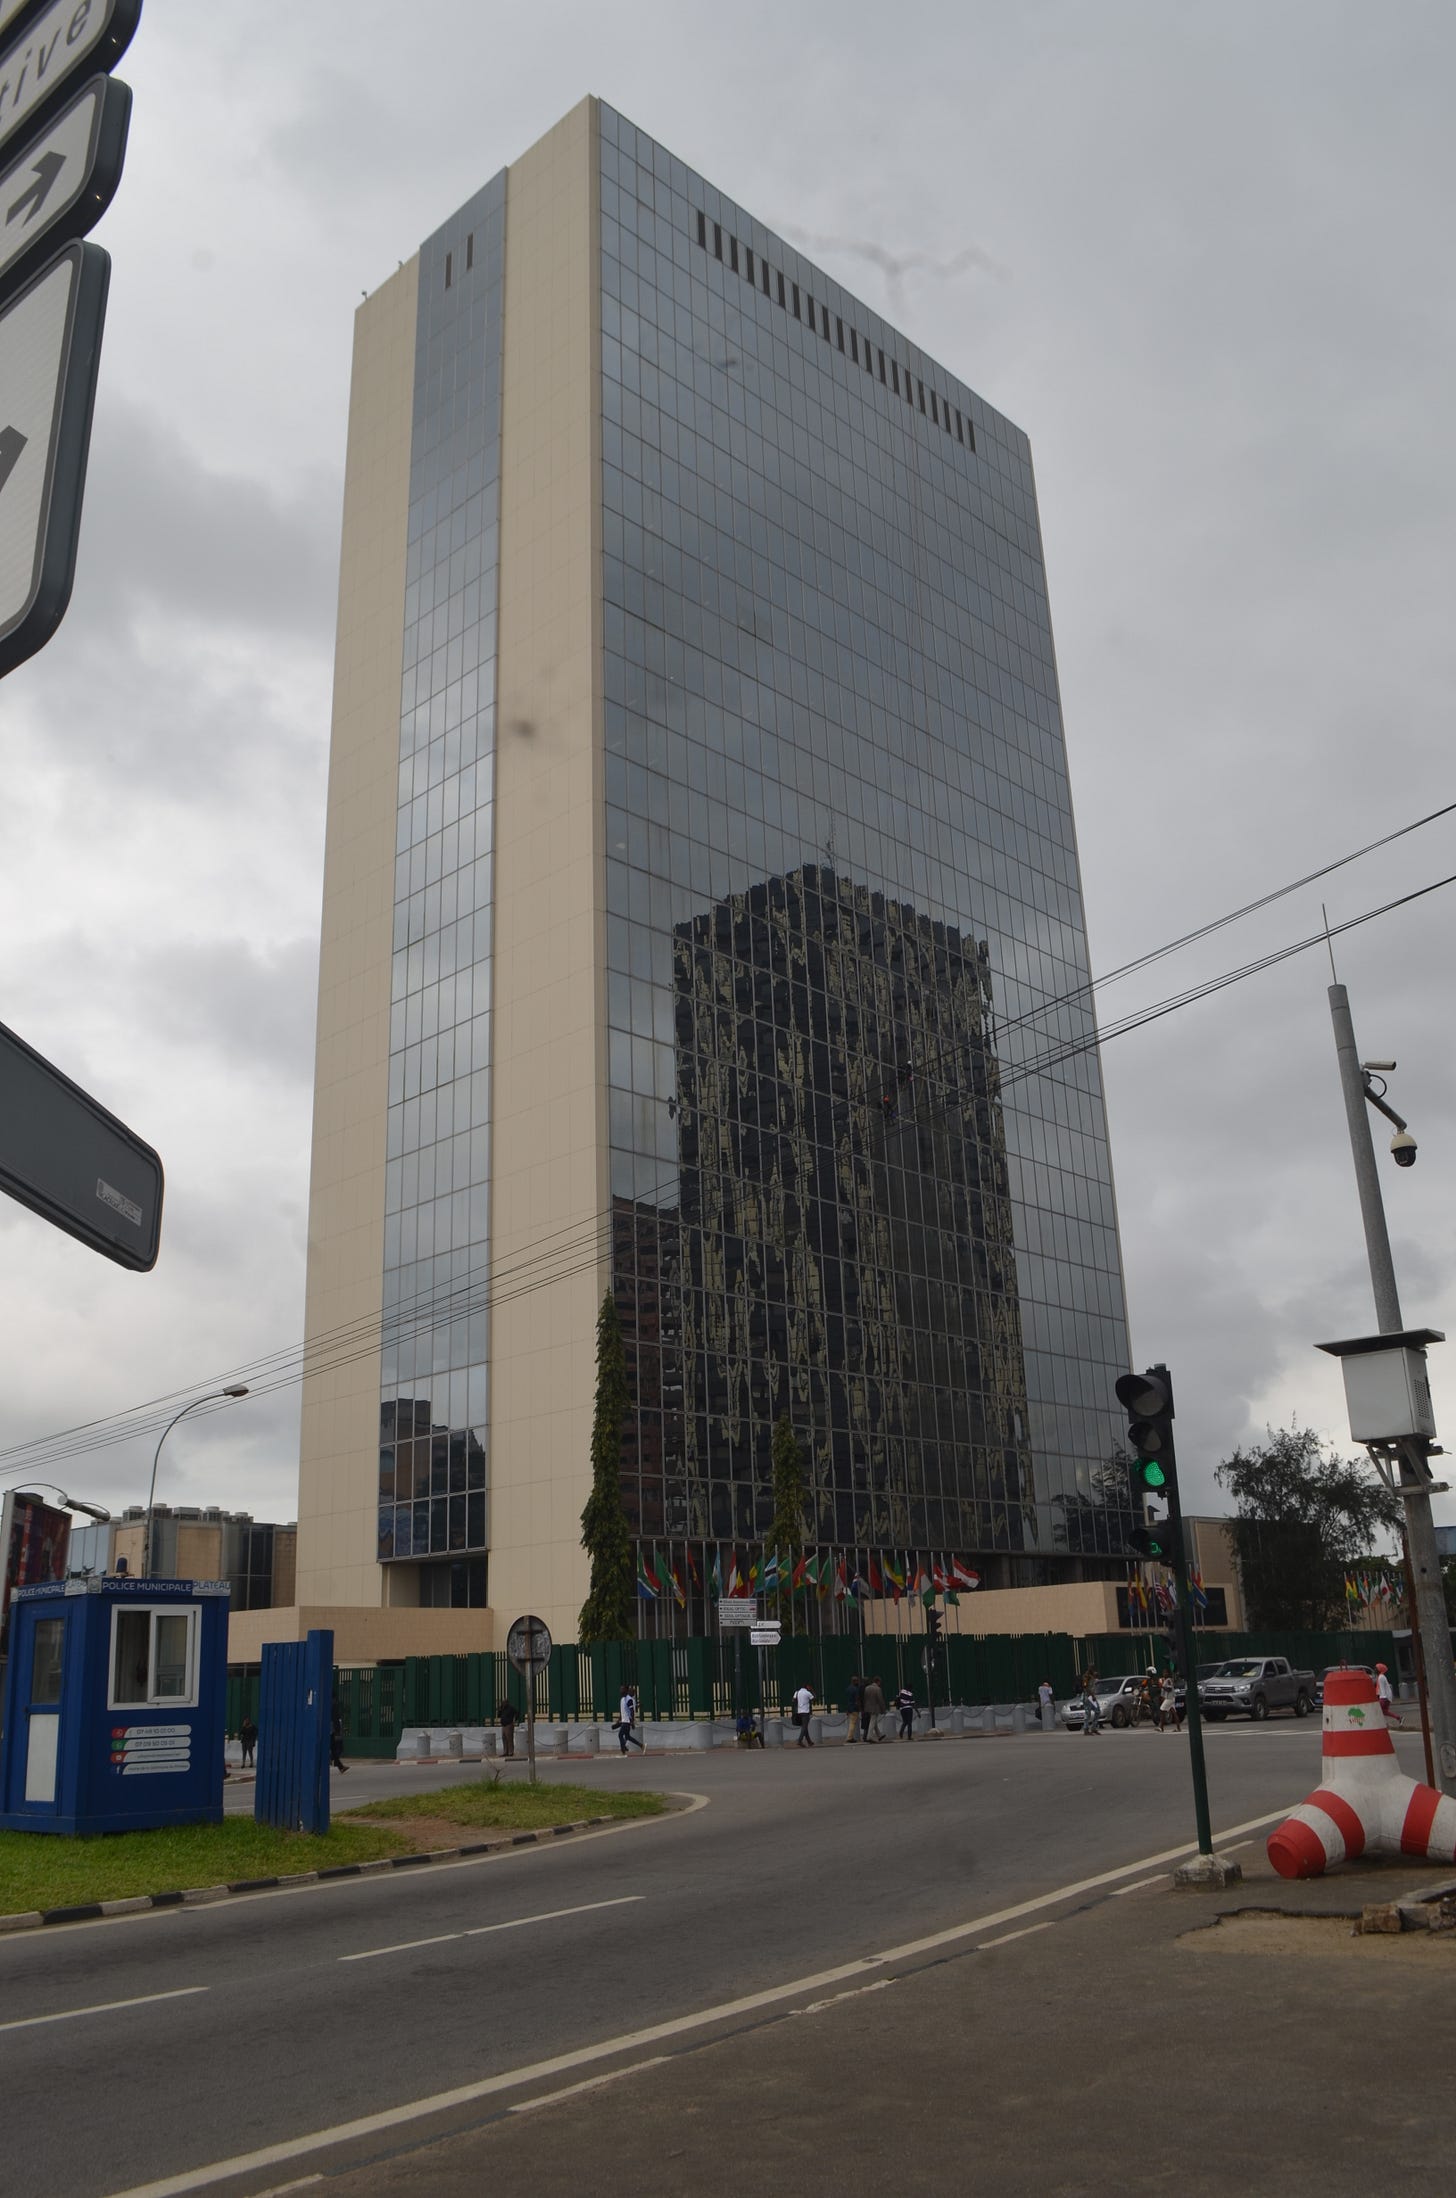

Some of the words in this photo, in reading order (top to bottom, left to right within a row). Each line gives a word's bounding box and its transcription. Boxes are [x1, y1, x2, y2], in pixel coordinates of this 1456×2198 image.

[102, 1581, 135, 1591] POLICE
[136, 1582, 192, 1592] MUNICIPALE
[193, 1580, 231, 1589] PLATEAU
[18, 1587, 35, 1597] POLICE
